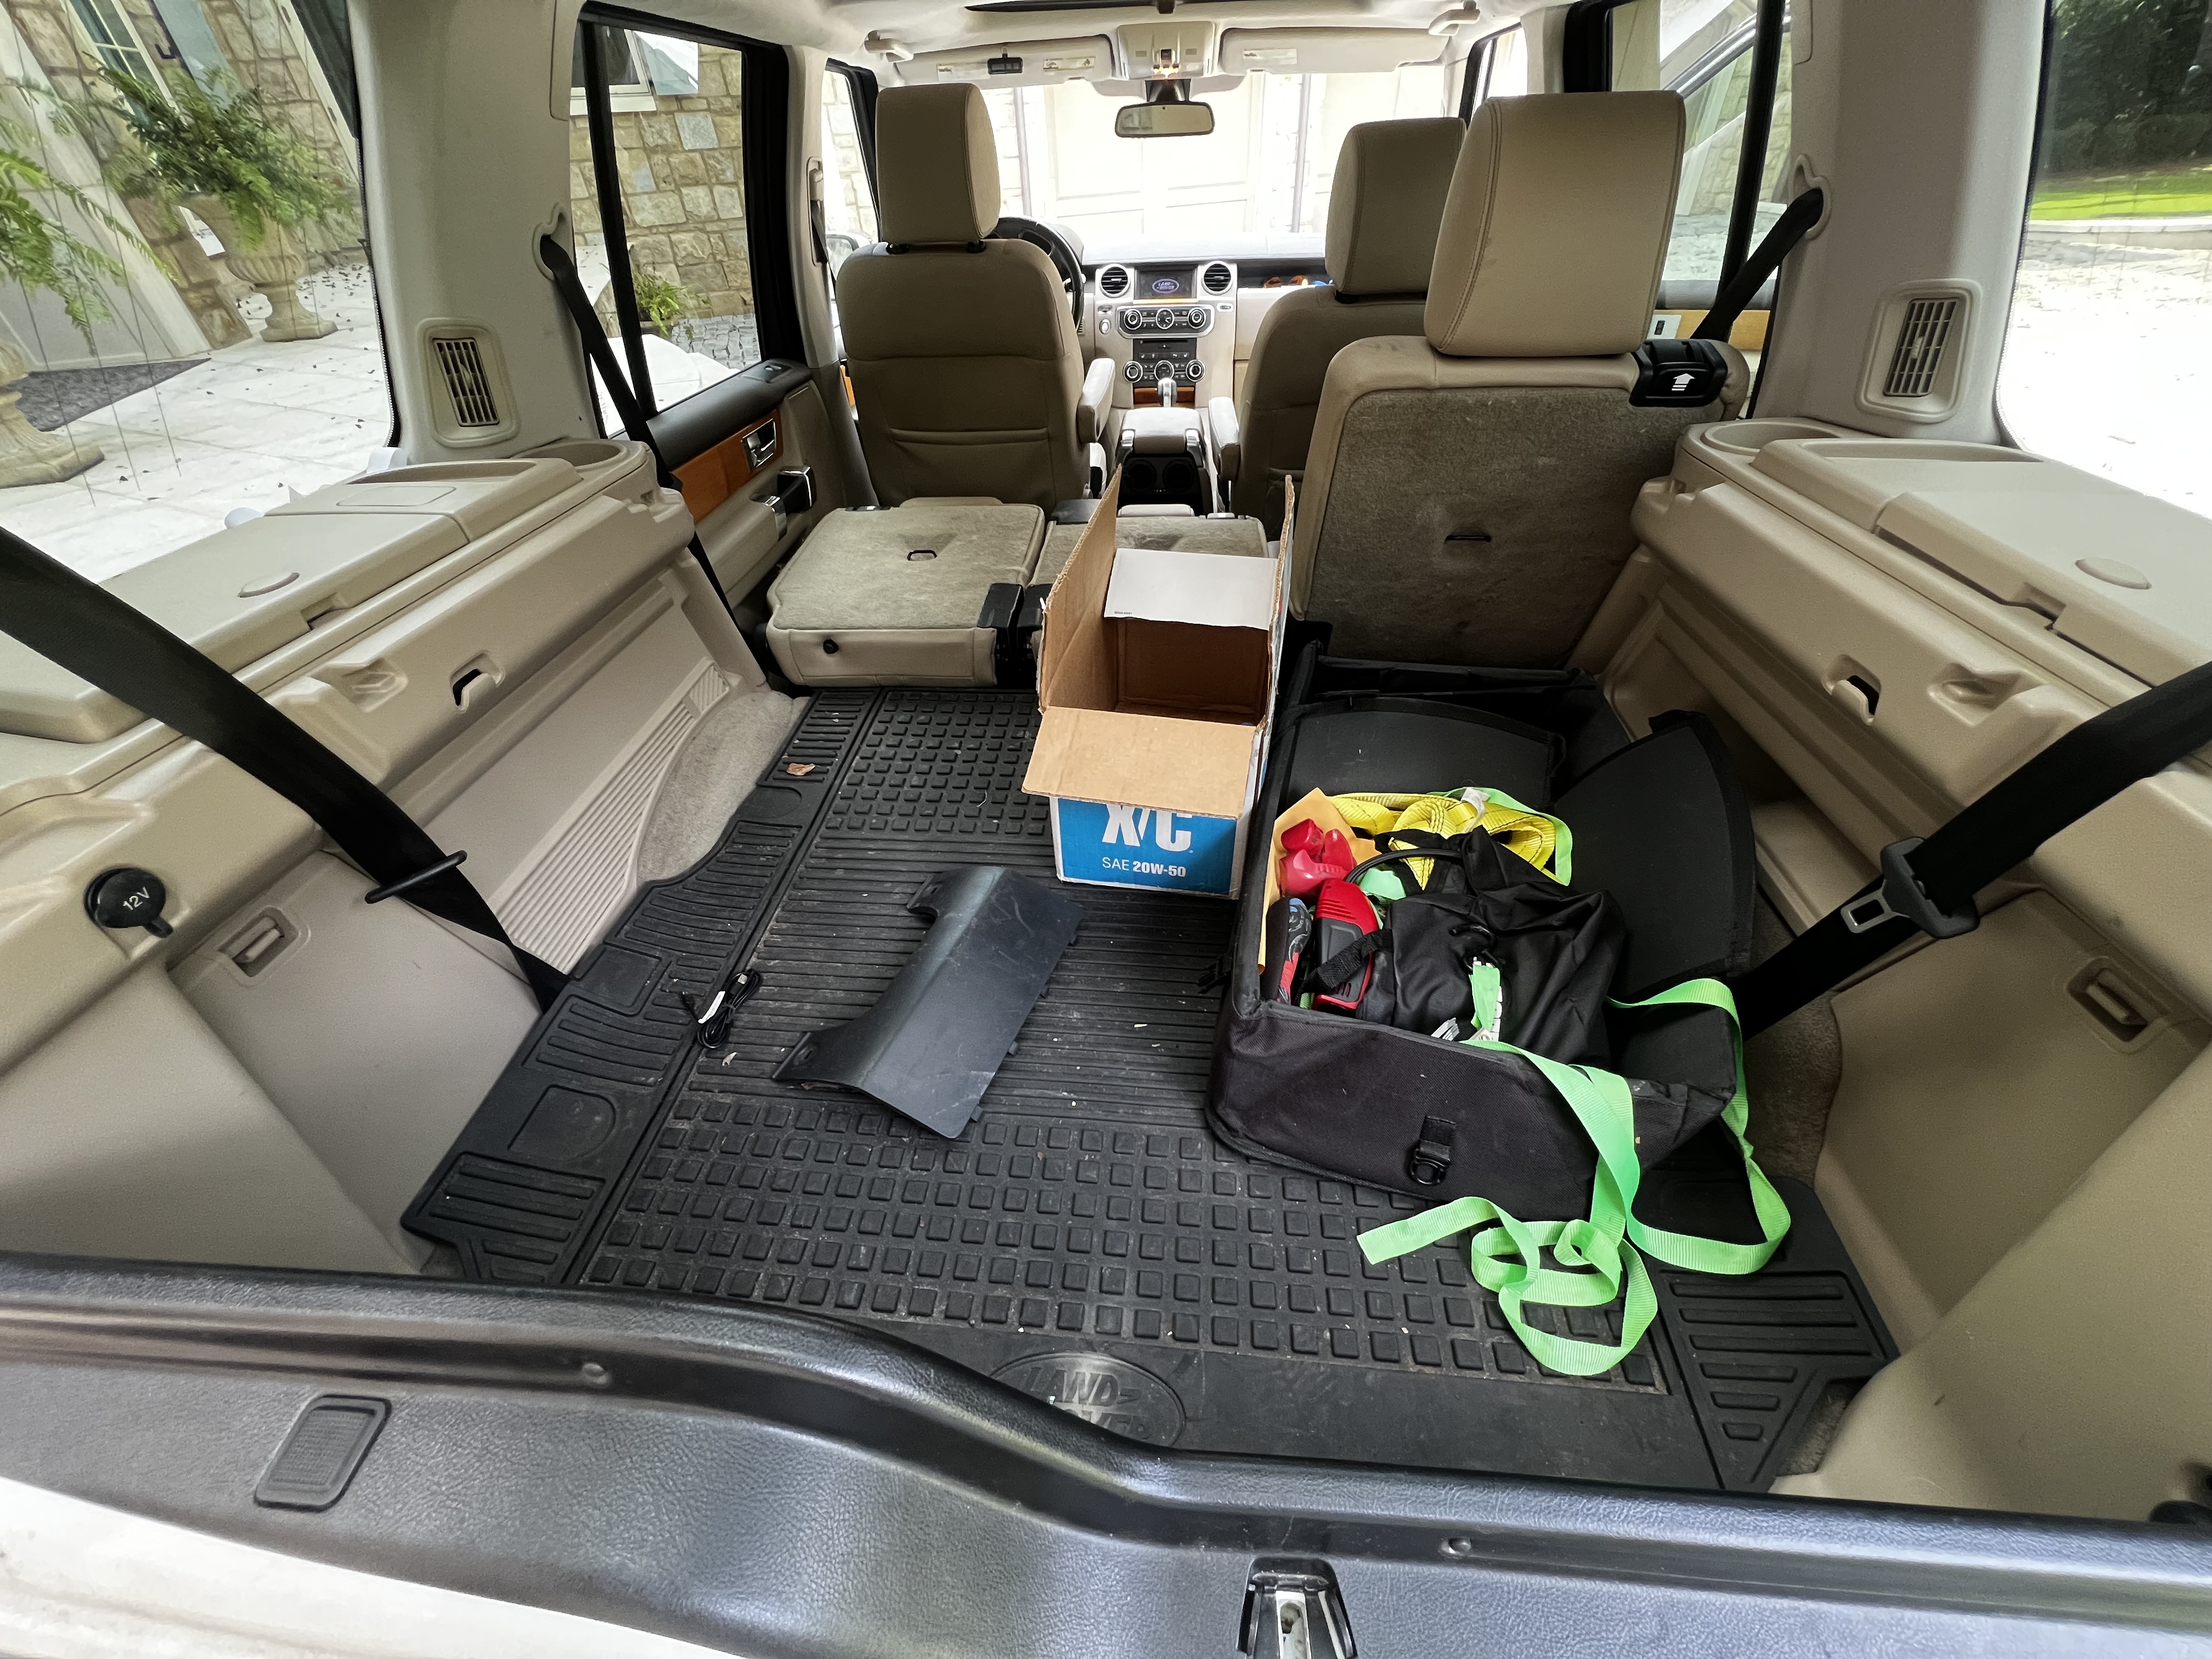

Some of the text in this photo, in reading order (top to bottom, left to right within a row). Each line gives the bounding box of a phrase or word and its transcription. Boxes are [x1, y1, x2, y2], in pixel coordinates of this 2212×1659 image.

[1102, 857, 1186, 877] SAE 20W-50
[122, 887, 150, 911] 12V
